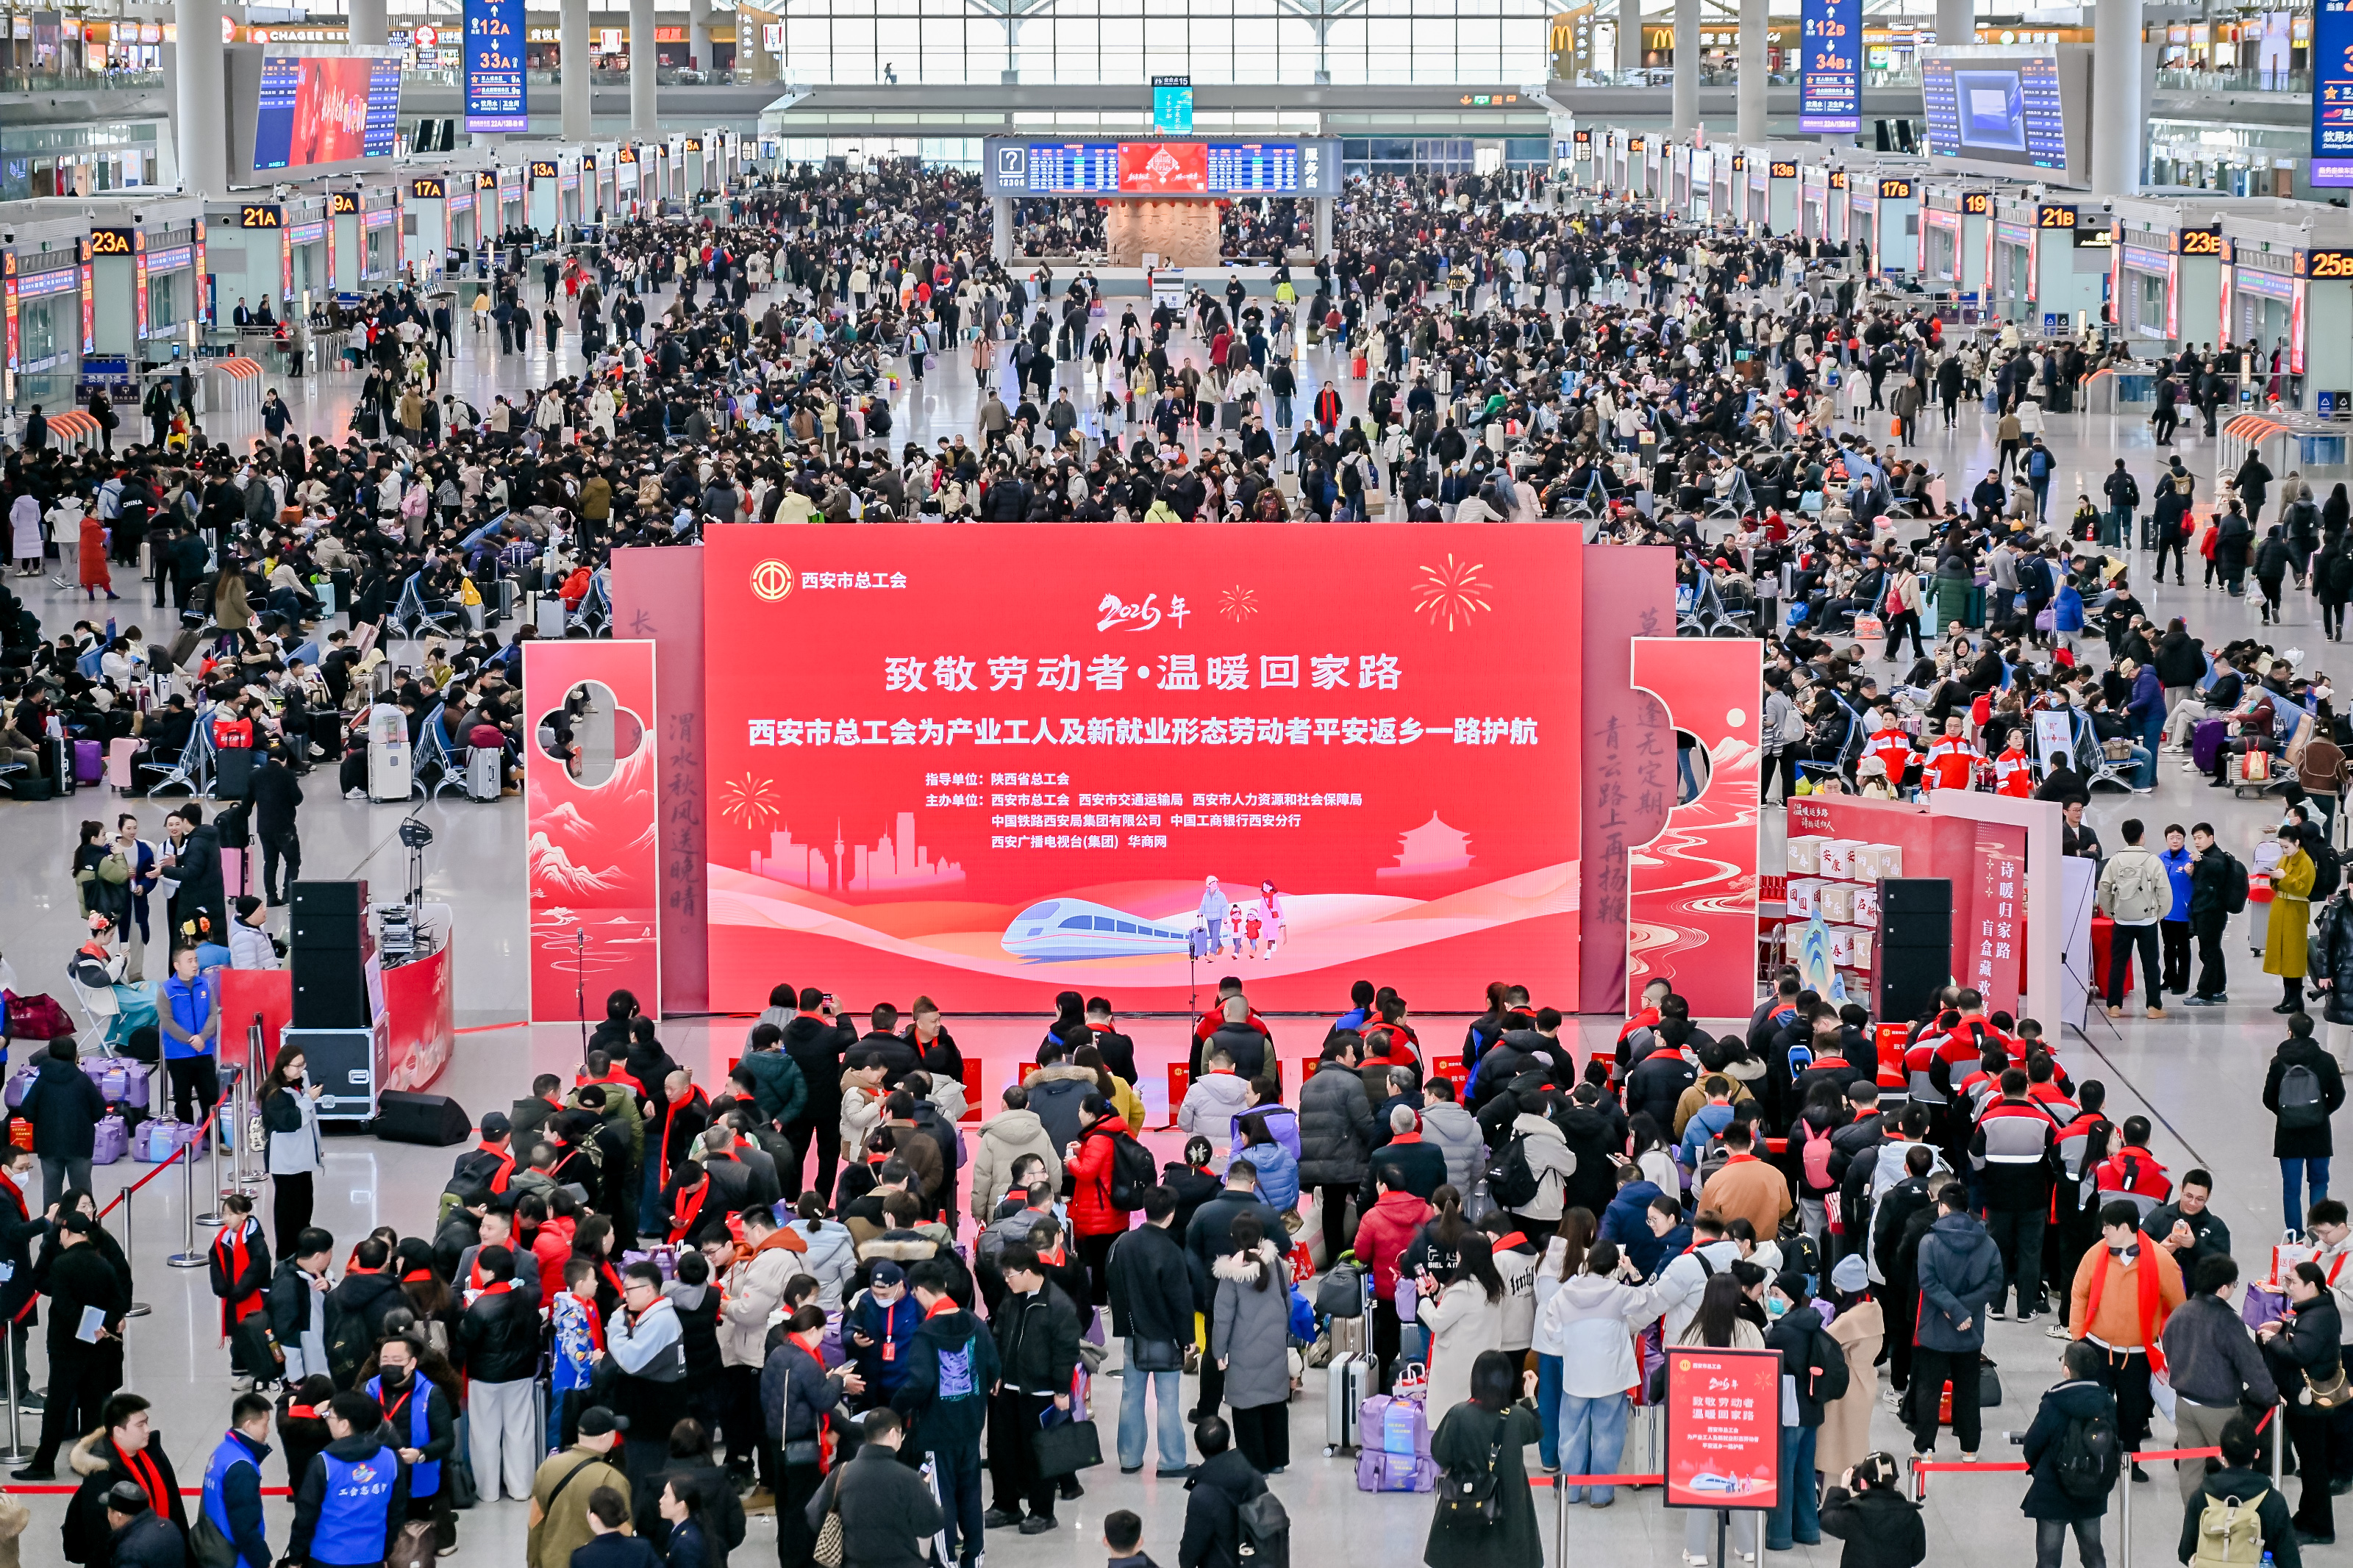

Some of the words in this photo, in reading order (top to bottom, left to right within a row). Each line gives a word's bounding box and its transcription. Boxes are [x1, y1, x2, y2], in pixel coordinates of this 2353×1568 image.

[2326, 2, 2344, 12] 当前
[480, 19, 510, 35] 12A
[1816, 21, 1846, 36] 12B
[269, 31, 324, 40] CHAGEE
[480, 52, 510, 68] 33A
[1816, 54, 1845, 70] 34B
[1179, 77, 1188, 85] 15
[1577, 132, 1588, 141] 1B
[532, 163, 555, 176] 13A
[1304, 148, 1319, 188] 服务台
[1771, 163, 1795, 176] 13B
[480, 174, 493, 187] 5A
[999, 179, 1025, 187] 12306
[1830, 173, 1844, 187] 15
[414, 181, 441, 196] 17A
[1881, 181, 1909, 197] 17B
[335, 195, 354, 212] 9A
[1965, 195, 1986, 212] 19
[243, 207, 276, 226] 21A
[2041, 207, 2075, 226] 21B
[93, 232, 129, 252] 23A
[82, 240, 92, 261] 24A
[5, 253, 16, 275] 25A
[2312, 253, 2353, 276] 25B
[123, 500, 143, 508] CHINA
[801, 571, 907, 589] 西安市总工会
[748, 717, 1538, 746] 西安市总工会为产业工人及新就业形态劳动者平安返乡一路护航
[1079, 793, 1183, 806] 西安市交通运输局
[1192, 792, 1363, 806] 西安市人力资源和社会保障局
[992, 814, 1161, 827] 中国铁路西安局集团有限公司
[1171, 814, 1302, 827] 中国工商银行西安分行
[992, 835, 1118, 849] 西安广播电视台(集团)
[1128, 835, 1167, 848] 华商网
[1823, 848, 1842, 873] 安康
[1857, 854, 1877, 878] 纳福
[1823, 893, 1843, 916] 喜乐
[1996, 861, 2015, 960] 诗暖归家路
[1692, 1395, 1754, 1408] 致敬劳动者
[1692, 1408, 1754, 1422] 温暖回家路
